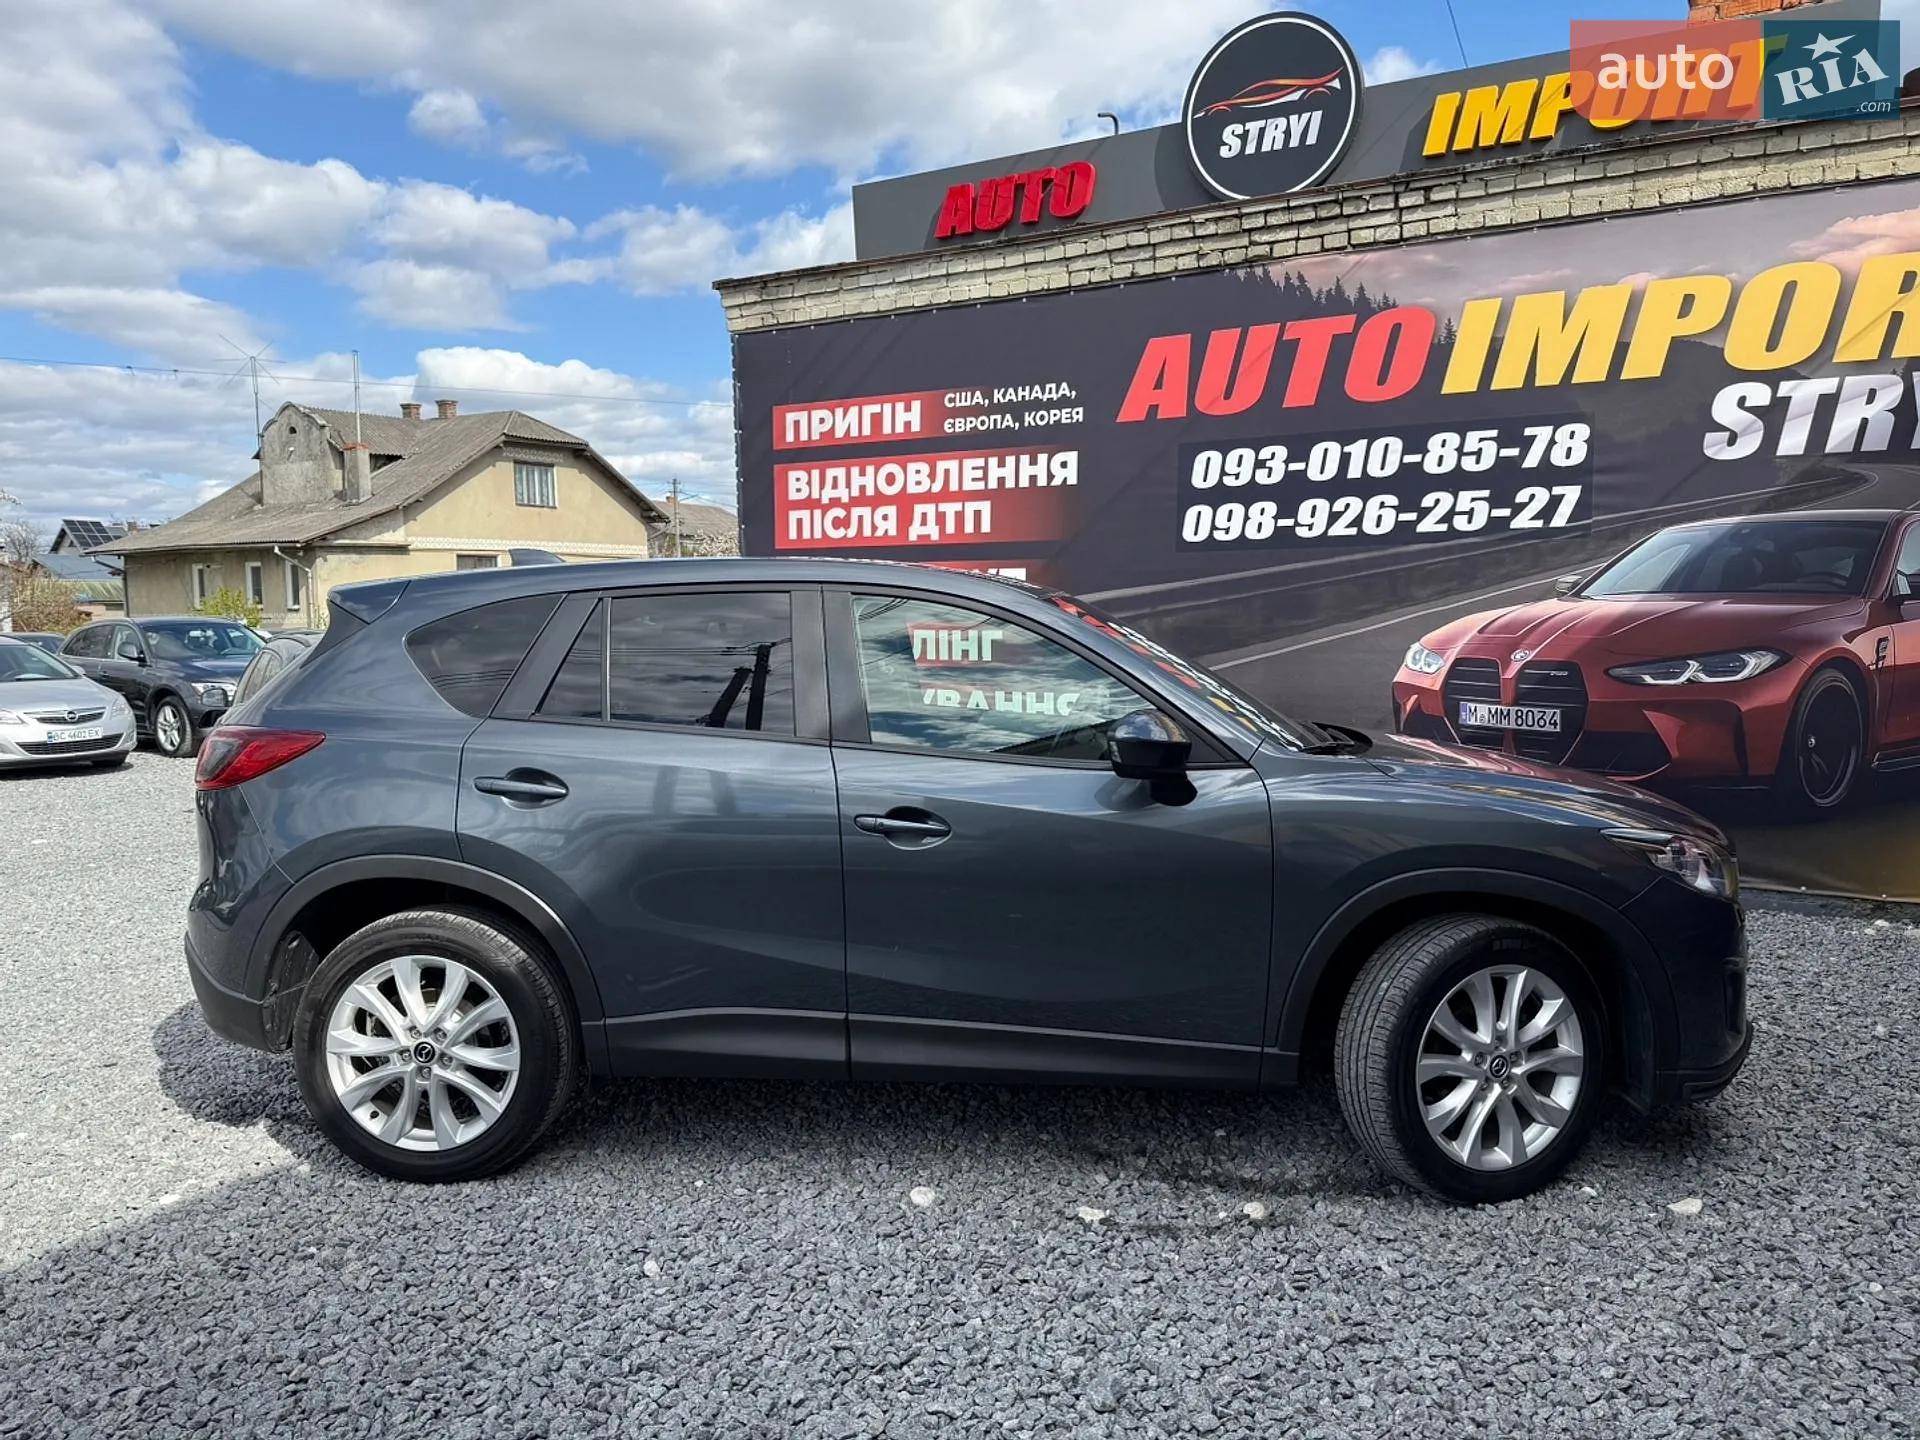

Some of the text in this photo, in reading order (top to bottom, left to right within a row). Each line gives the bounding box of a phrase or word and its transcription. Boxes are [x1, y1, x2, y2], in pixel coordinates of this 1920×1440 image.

[1220, 110, 1323, 158] STRYI
[933, 160, 1096, 240] AUTO
[943, 406, 1084, 434] ЄВРОПА, КОРЕЯ
[944, 381, 1077, 409] США, КАНАДА,
[1703, 370, 1920, 460] STR
[785, 400, 922, 443] ПРИГІН
[787, 450, 1079, 504] ВІДНОВЛЕННЯ
[1190, 423, 1591, 490] 093-010-85-78
[788, 500, 992, 541] ПІСЛЯ ДТП
[1181, 485, 1583, 543] 098-926-25-27
